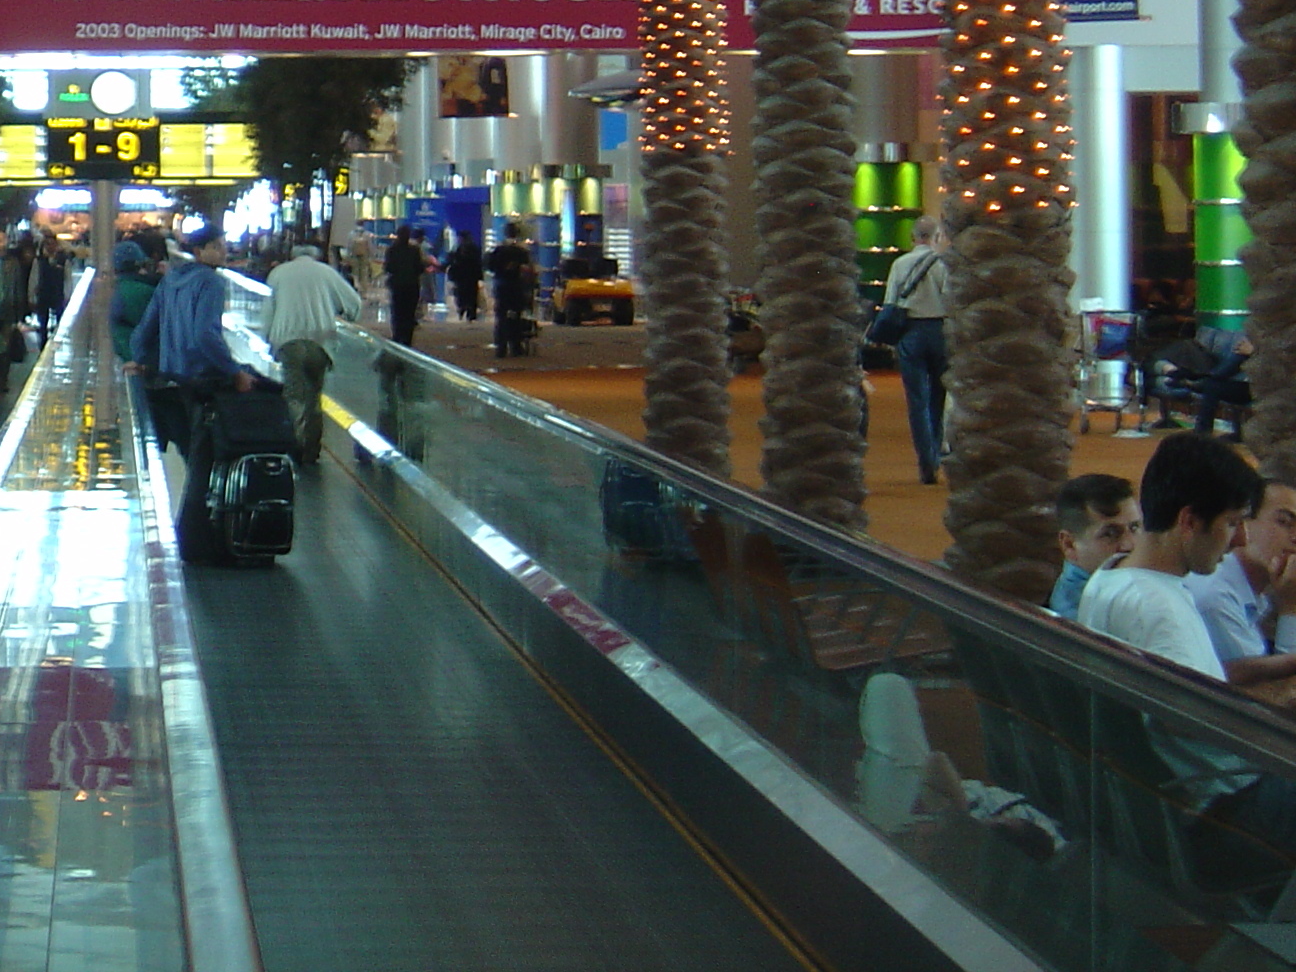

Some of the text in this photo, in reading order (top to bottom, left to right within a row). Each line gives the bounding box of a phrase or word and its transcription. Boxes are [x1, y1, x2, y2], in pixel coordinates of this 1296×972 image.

[74, 22, 626, 41] 2003 Openings: JW Marriott Kuwait, JW Marriott, Mirage City, Cairo
